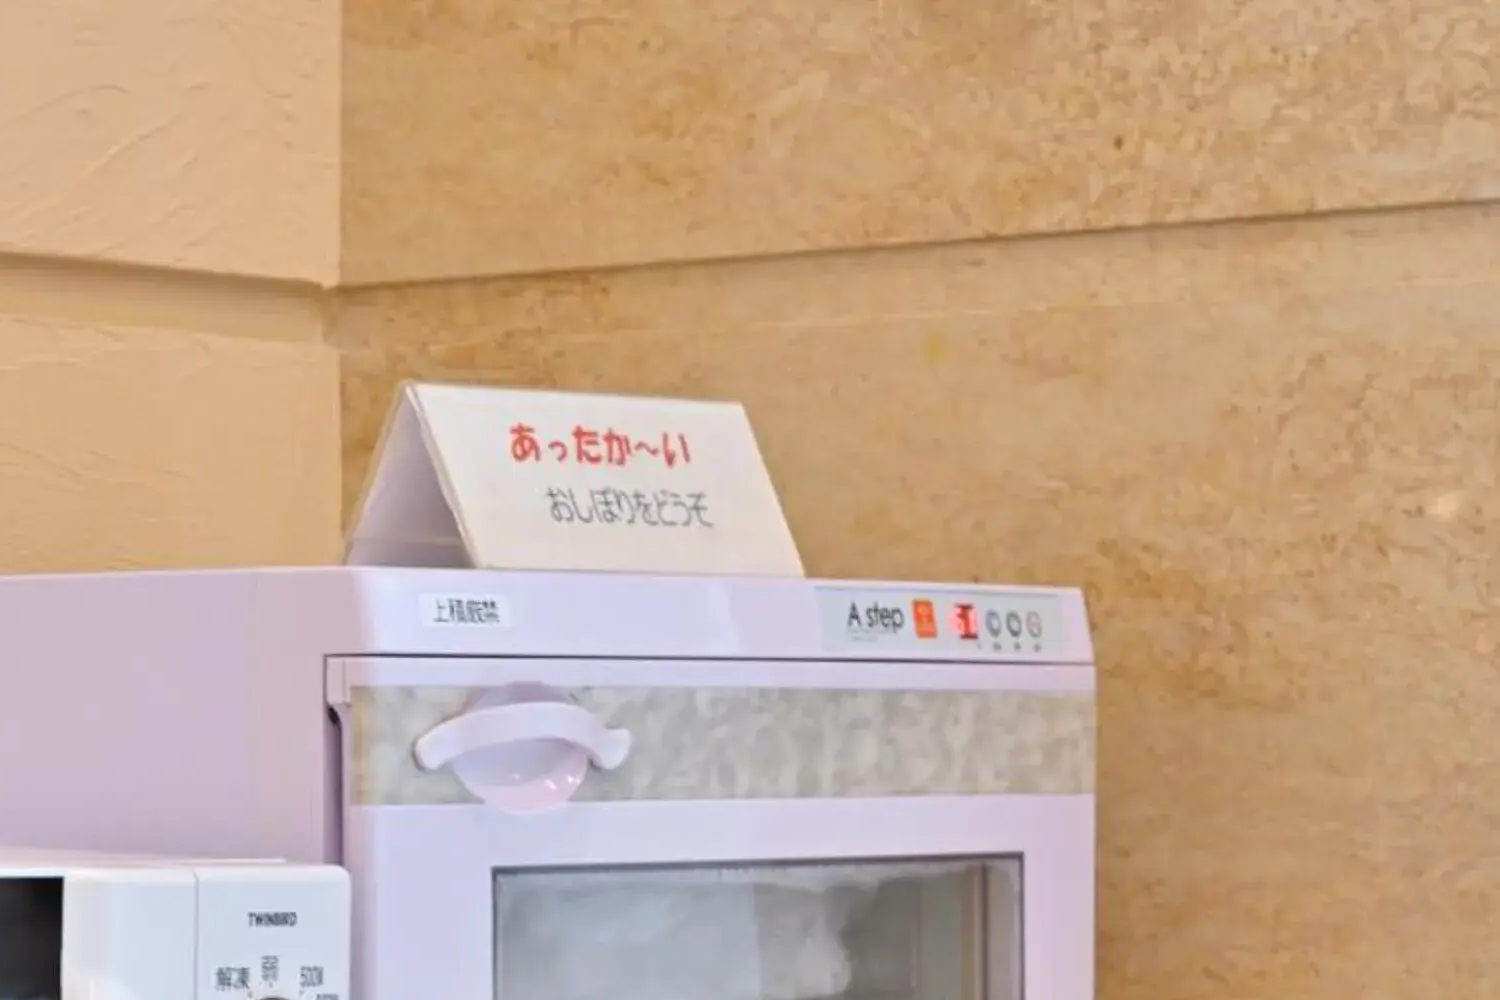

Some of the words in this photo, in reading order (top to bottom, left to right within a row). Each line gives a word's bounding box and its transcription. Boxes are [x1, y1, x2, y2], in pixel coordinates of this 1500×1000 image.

[547, 487, 713, 527] おしぼりをどうぞ
[848, 601, 861, 626] A
[866, 602, 905, 633] step
[248, 912, 297, 927] TWINBIRD
